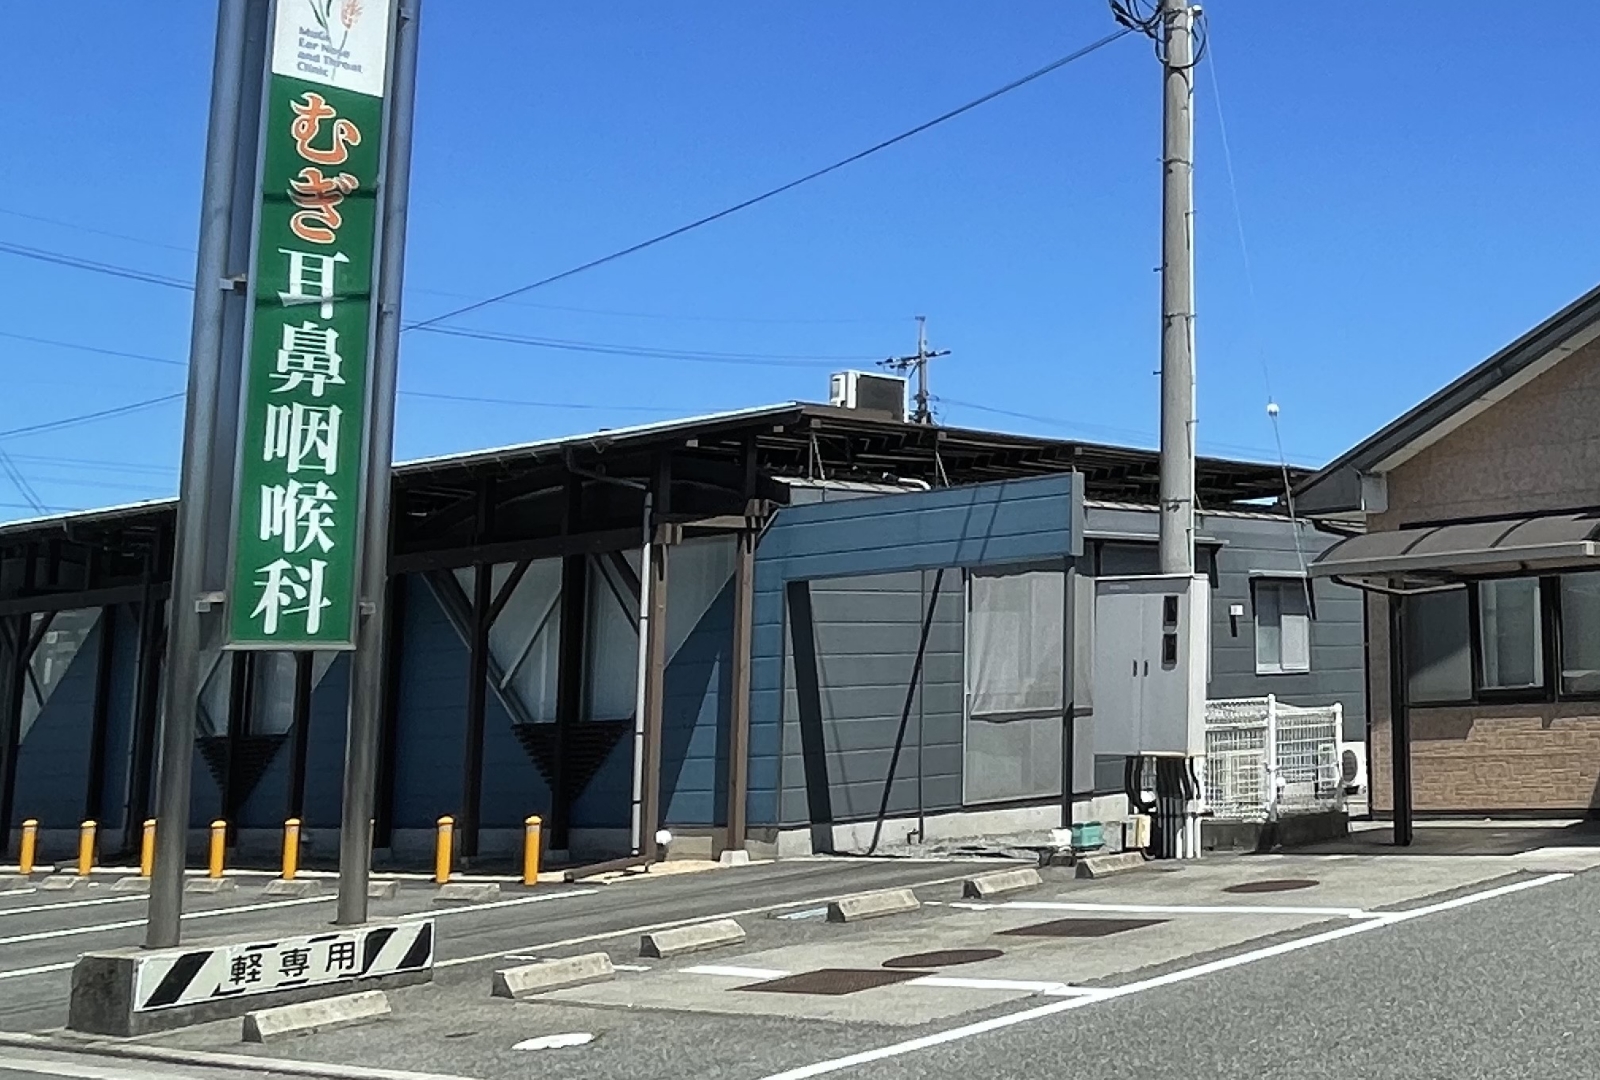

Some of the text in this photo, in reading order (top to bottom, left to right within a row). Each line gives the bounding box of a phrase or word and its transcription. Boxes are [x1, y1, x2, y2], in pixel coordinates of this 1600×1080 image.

[298, 37, 319, 50] Ear
[297, 61, 328, 77] Clinic
[250, 92, 361, 634] むぎ耳鼻咽喉科
[229, 940, 356, 986] 軽専用
